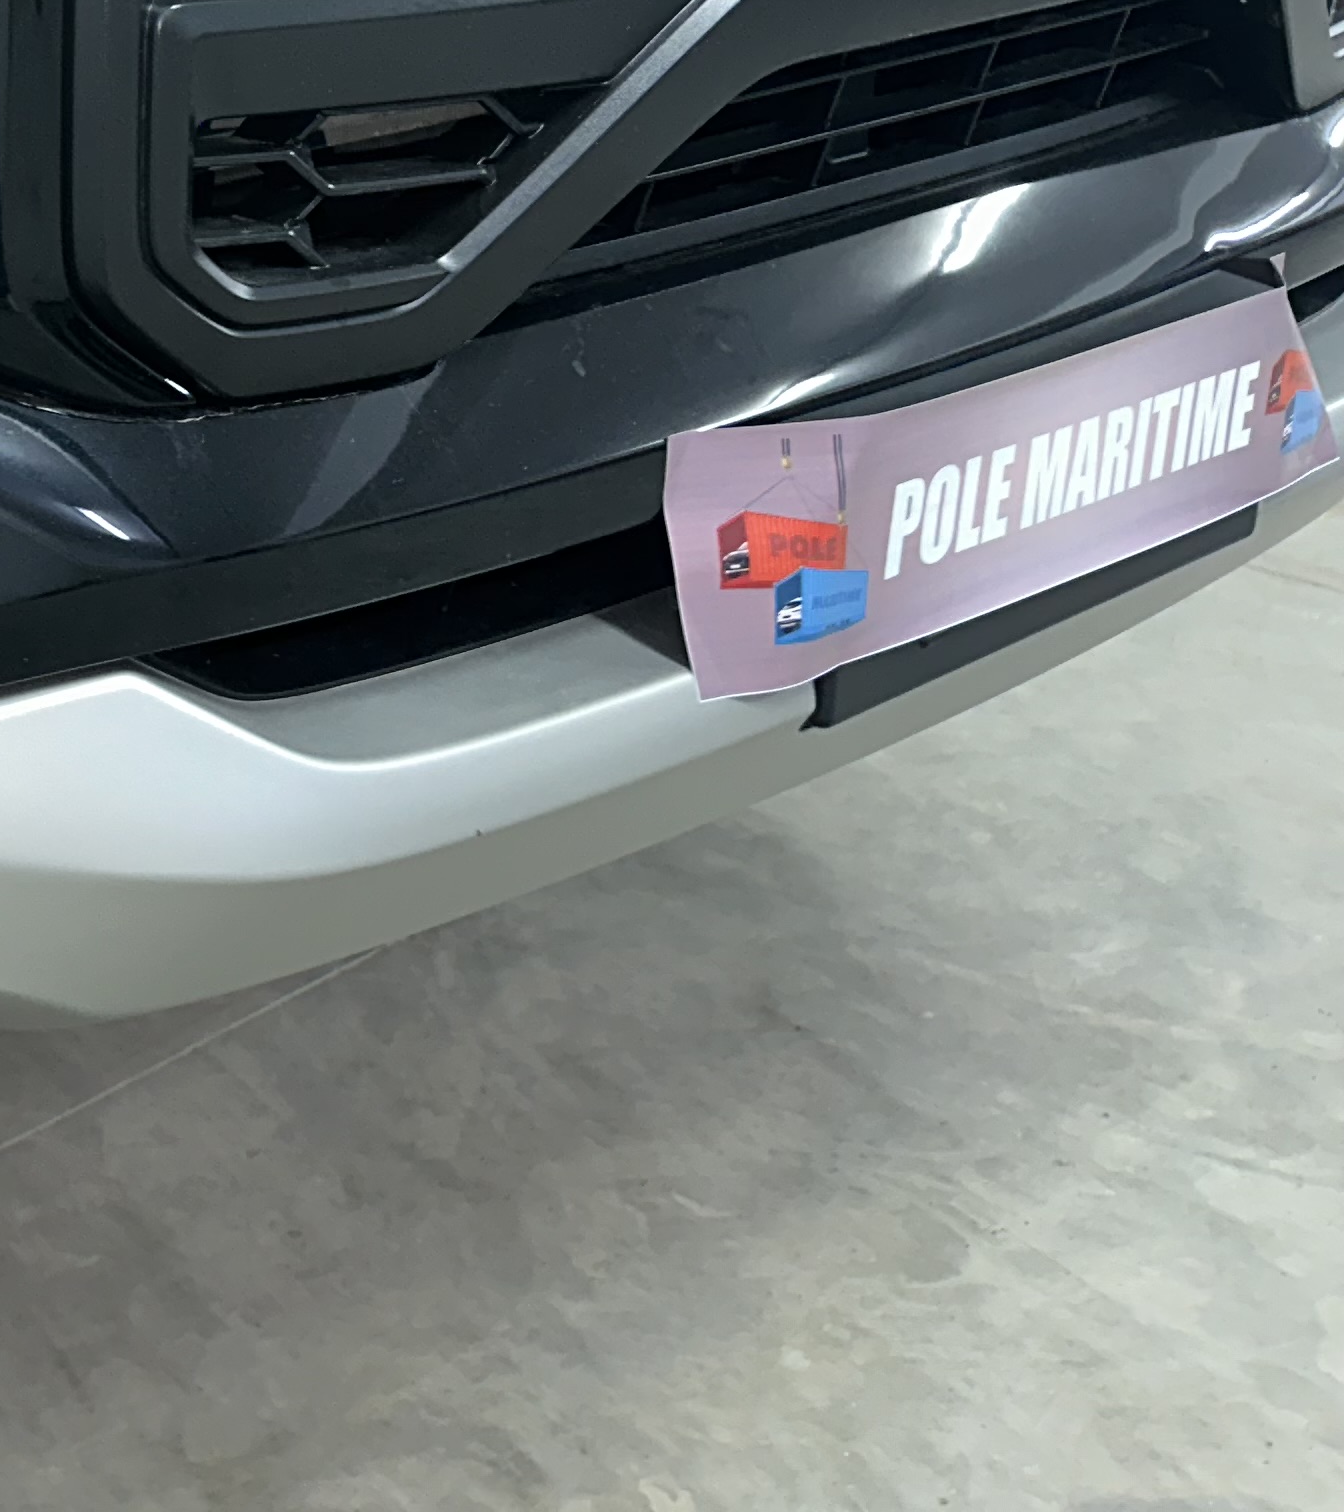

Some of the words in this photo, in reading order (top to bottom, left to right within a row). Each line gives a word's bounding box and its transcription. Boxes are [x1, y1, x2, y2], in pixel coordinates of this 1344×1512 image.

[883, 443, 1017, 581] POLE
[1019, 359, 1261, 530] MARITIME
[768, 532, 838, 562] POLE
